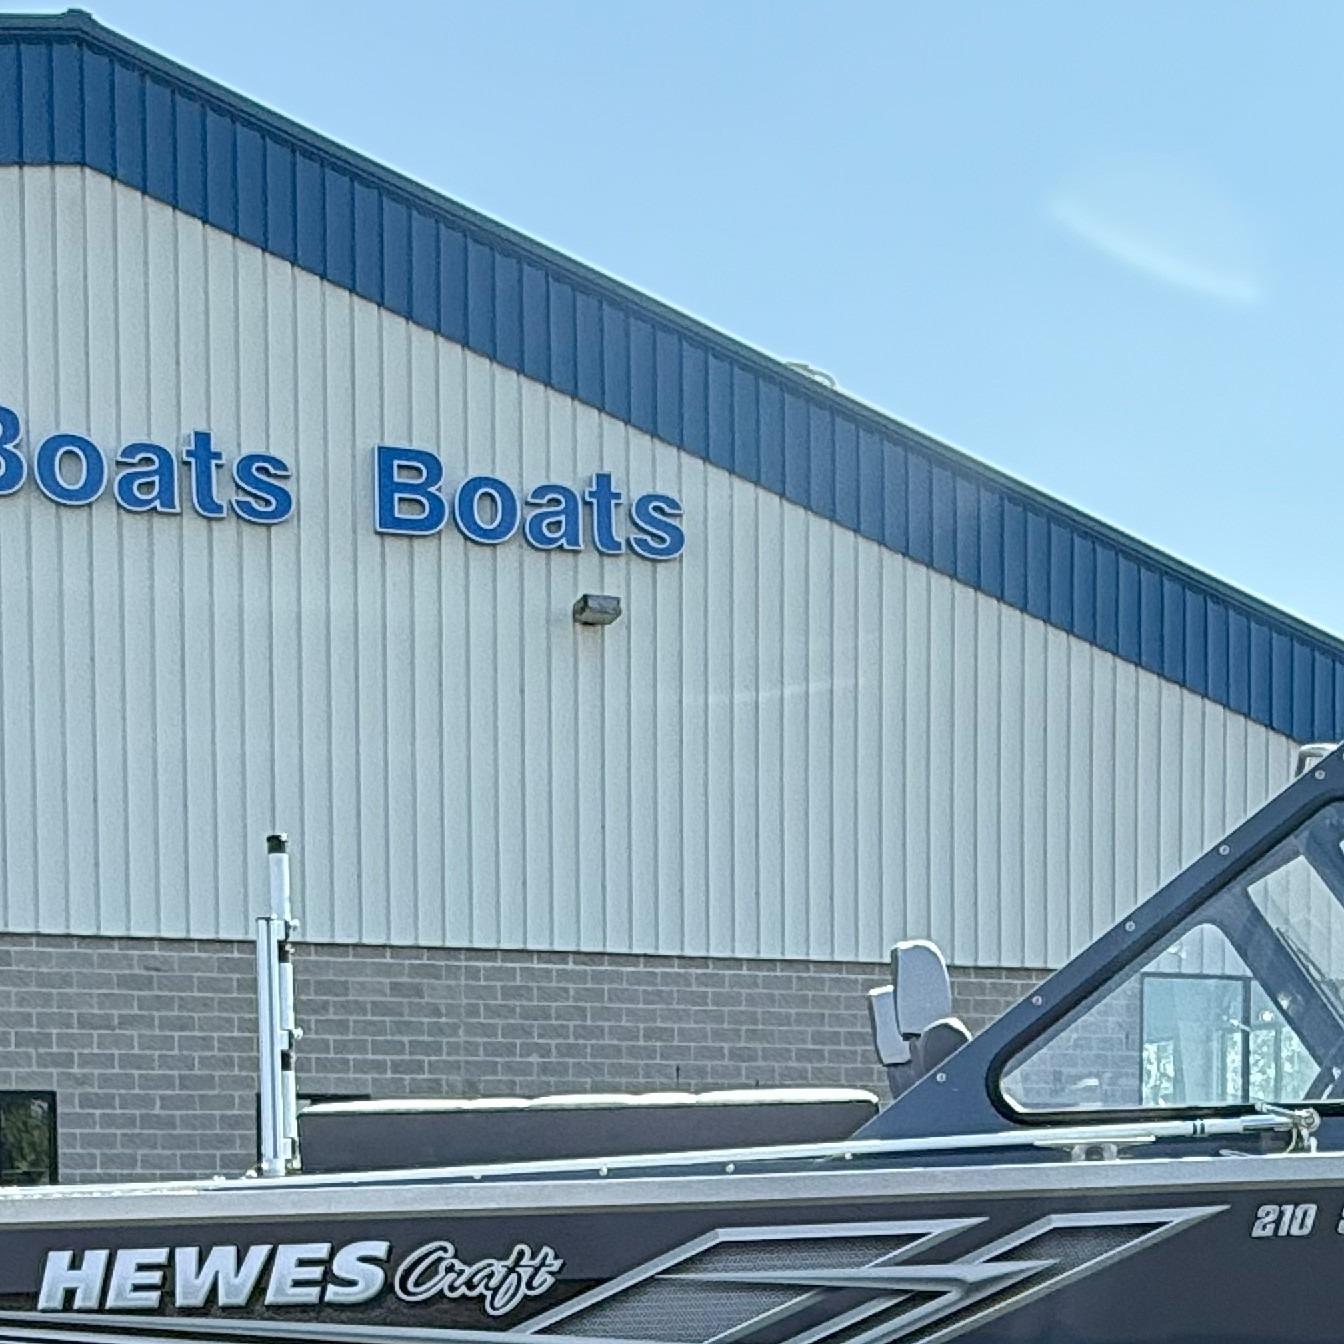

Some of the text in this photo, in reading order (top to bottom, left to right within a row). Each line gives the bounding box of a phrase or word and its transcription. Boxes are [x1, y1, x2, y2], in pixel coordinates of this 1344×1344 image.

[374, 444, 687, 561] Boats
[1250, 1204, 1318, 1238] 210
[37, 1240, 564, 1317] HEWES Craft
